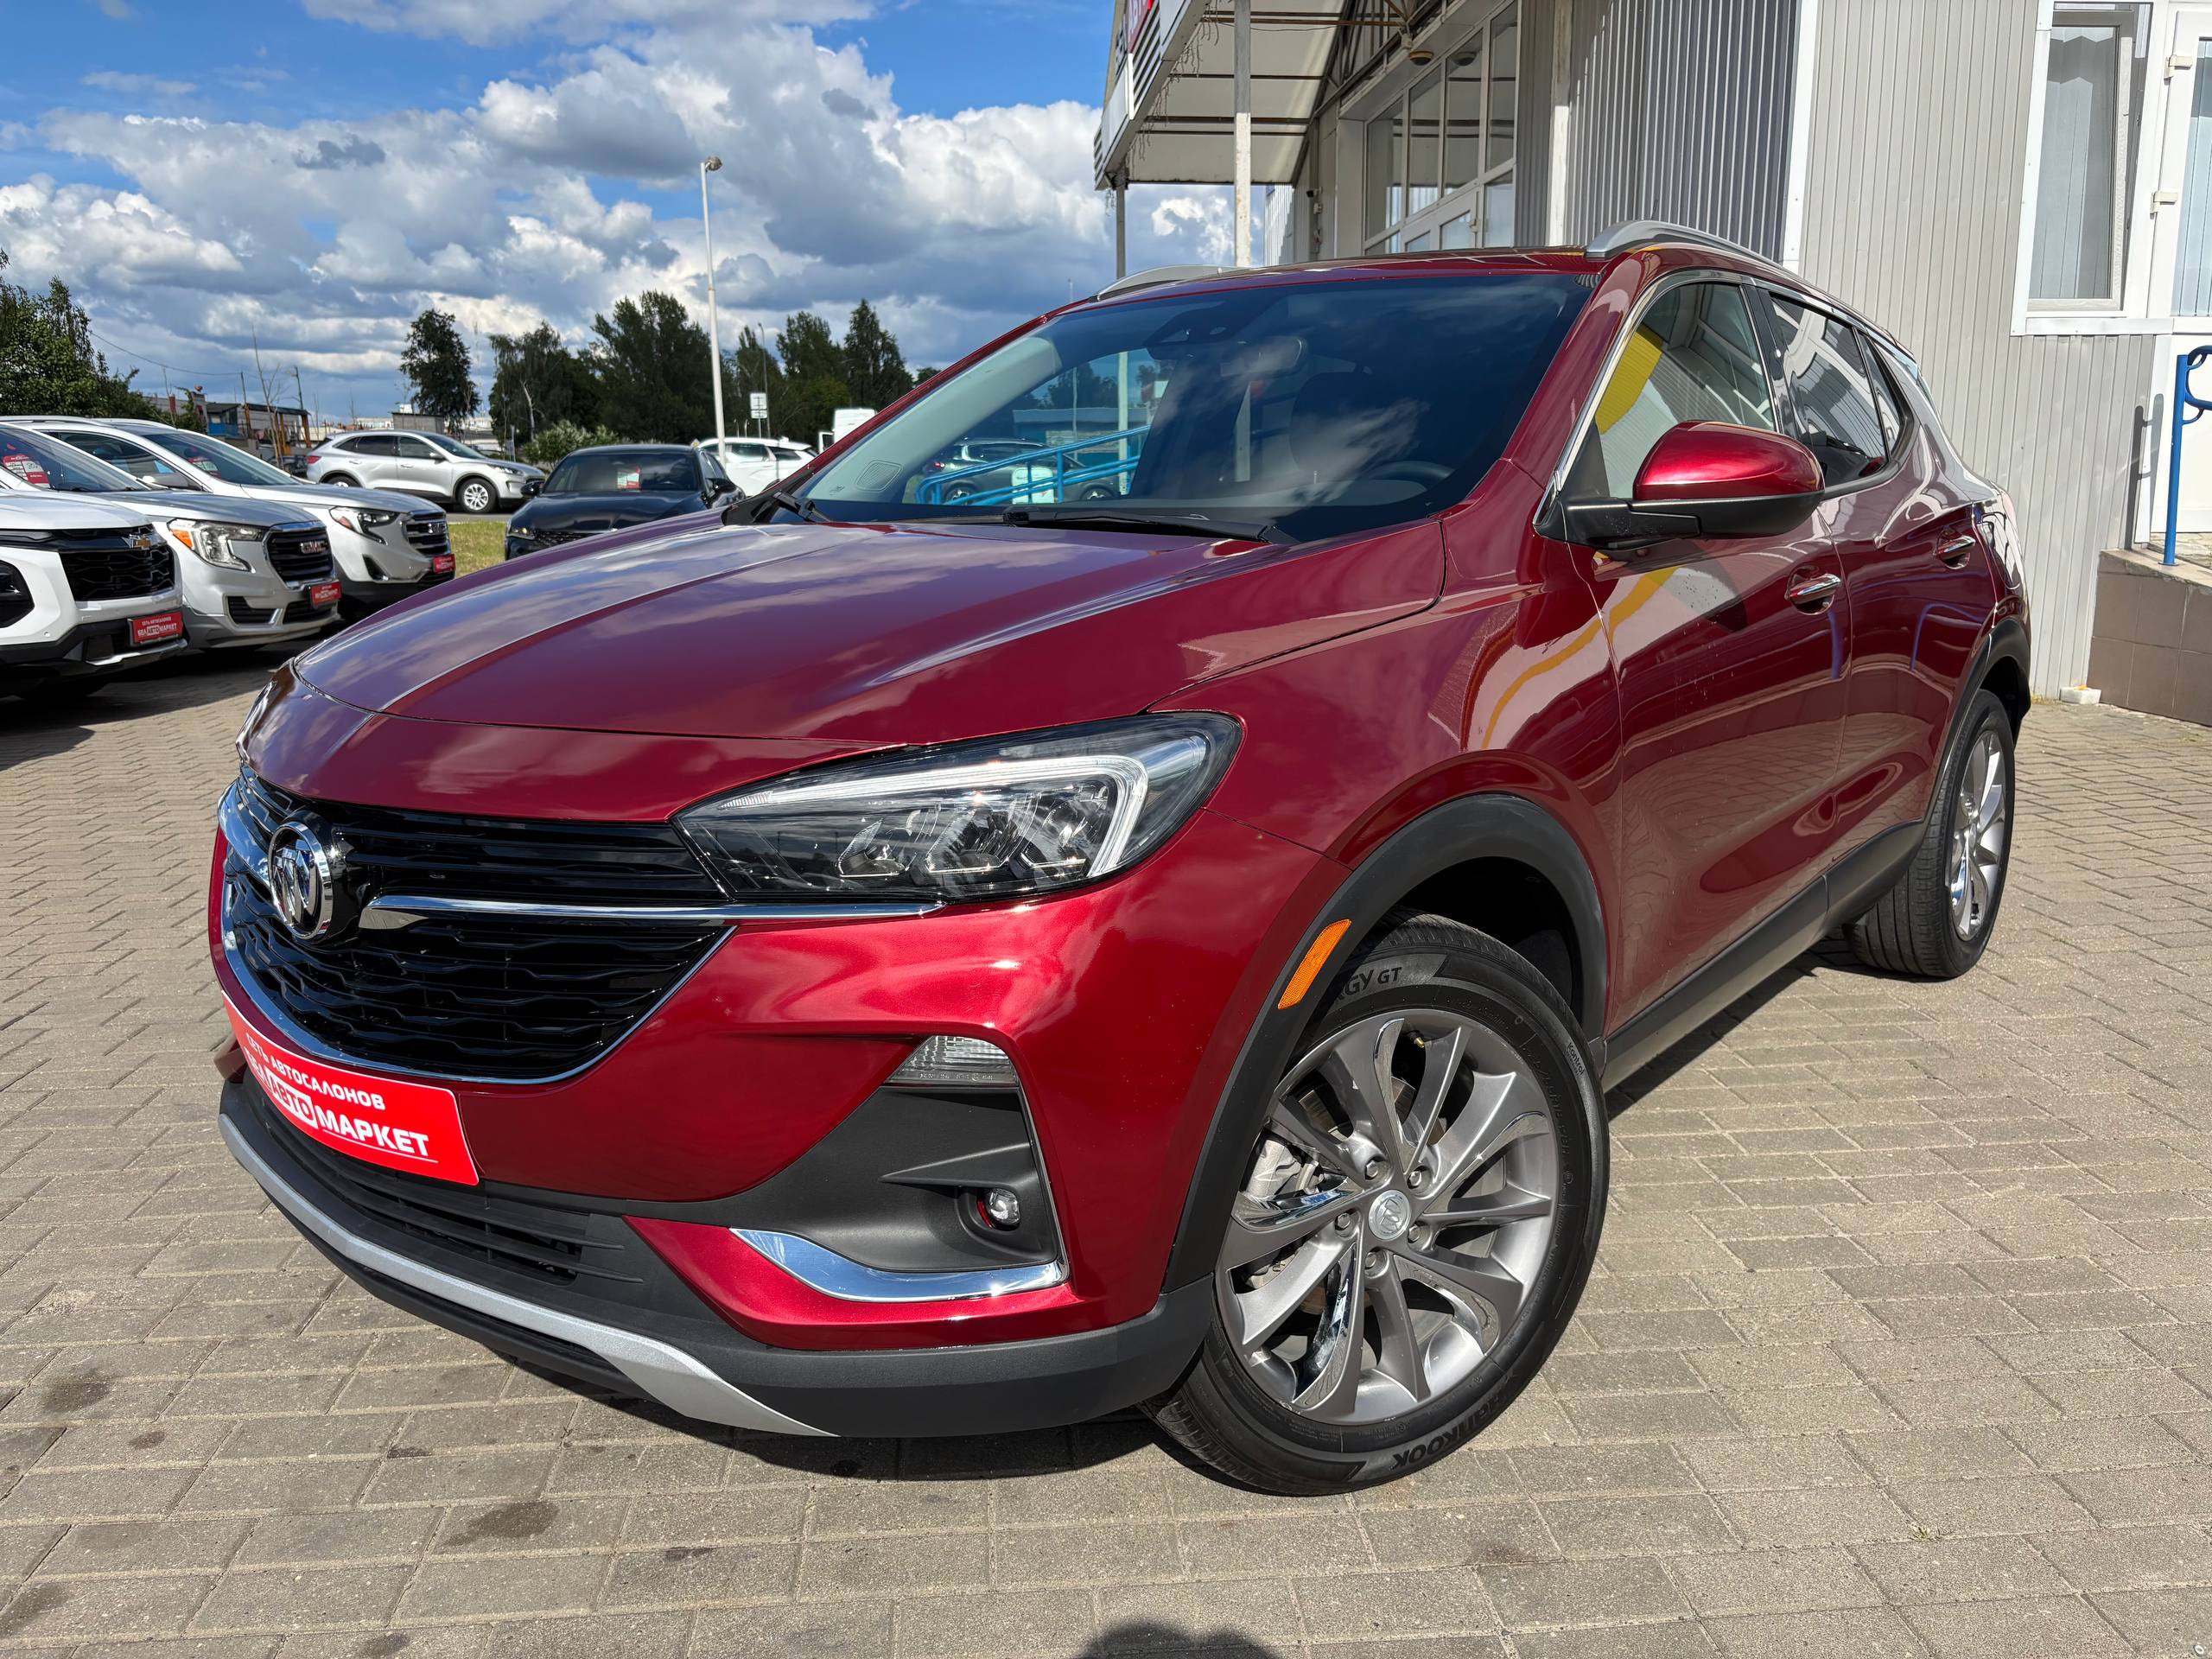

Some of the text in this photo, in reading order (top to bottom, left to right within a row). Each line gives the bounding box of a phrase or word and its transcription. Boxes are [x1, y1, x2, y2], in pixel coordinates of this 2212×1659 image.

[1376, 966, 1402, 984] GT
[246, 1033, 386, 1110] СЕТЬ АВТОСАЛОНОВ
